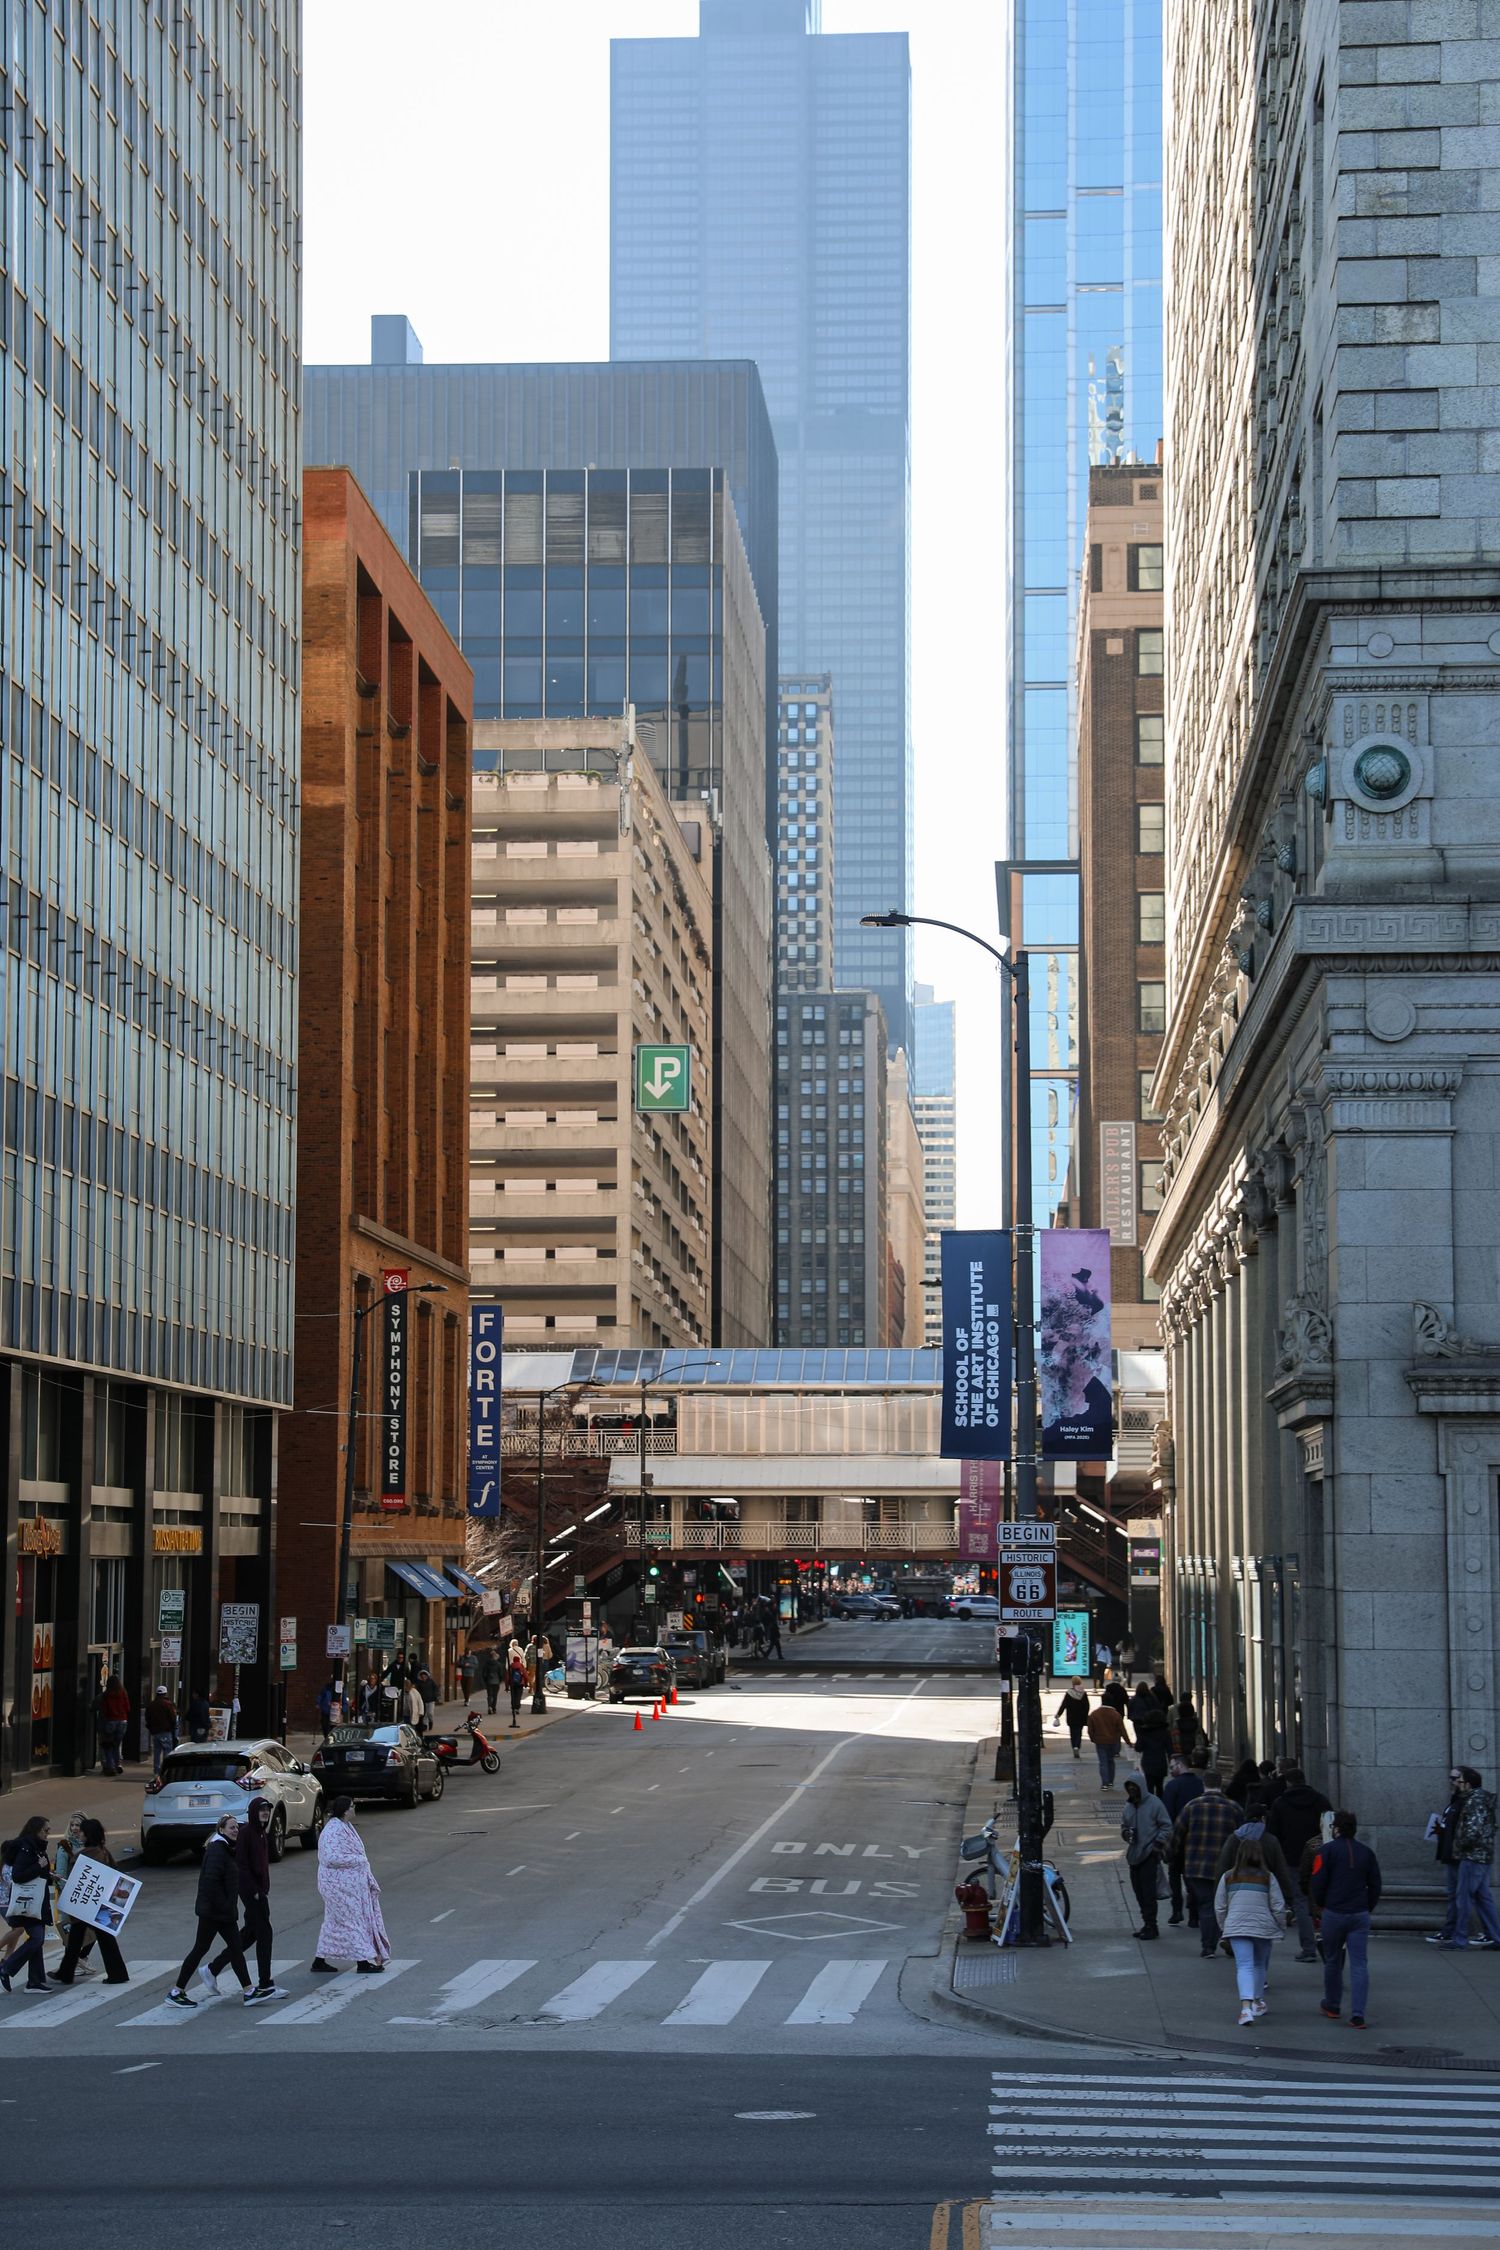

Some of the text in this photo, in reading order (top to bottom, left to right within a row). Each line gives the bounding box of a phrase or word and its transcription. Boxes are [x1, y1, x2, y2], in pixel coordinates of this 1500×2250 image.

[1105, 1126, 1120, 1237] MILLER'S PUB
[1120, 1127, 1132, 1240] RESTAURANT
[969, 1261, 984, 1427] THE ART INSTITUTE
[475, 1313, 497, 1446] FORTE
[955, 1327, 969, 1427] SCHOOL OF
[986, 1321, 999, 1427] OF CHICAGO
[389, 1304, 401, 1484] SYMPHONY STORE
[1059, 1425, 1094, 1434] Haley Kim
[968, 1475, 978, 1512] HARRIS
[1003, 1527, 1049, 1540] BEGIN
[1006, 1553, 1048, 1562] HISTORIC
[1016, 1584, 1040, 1600] 66
[224, 1606, 256, 1615] BEGIN
[1013, 1609, 1043, 1617] ROUTE
[770, 1841, 935, 1859] ONLY
[69, 1864, 92, 1905] NAMES
[79, 1874, 100, 1905] THEIR
[91, 1883, 105, 1905] SAY
[748, 1877, 921, 1898] BUS
